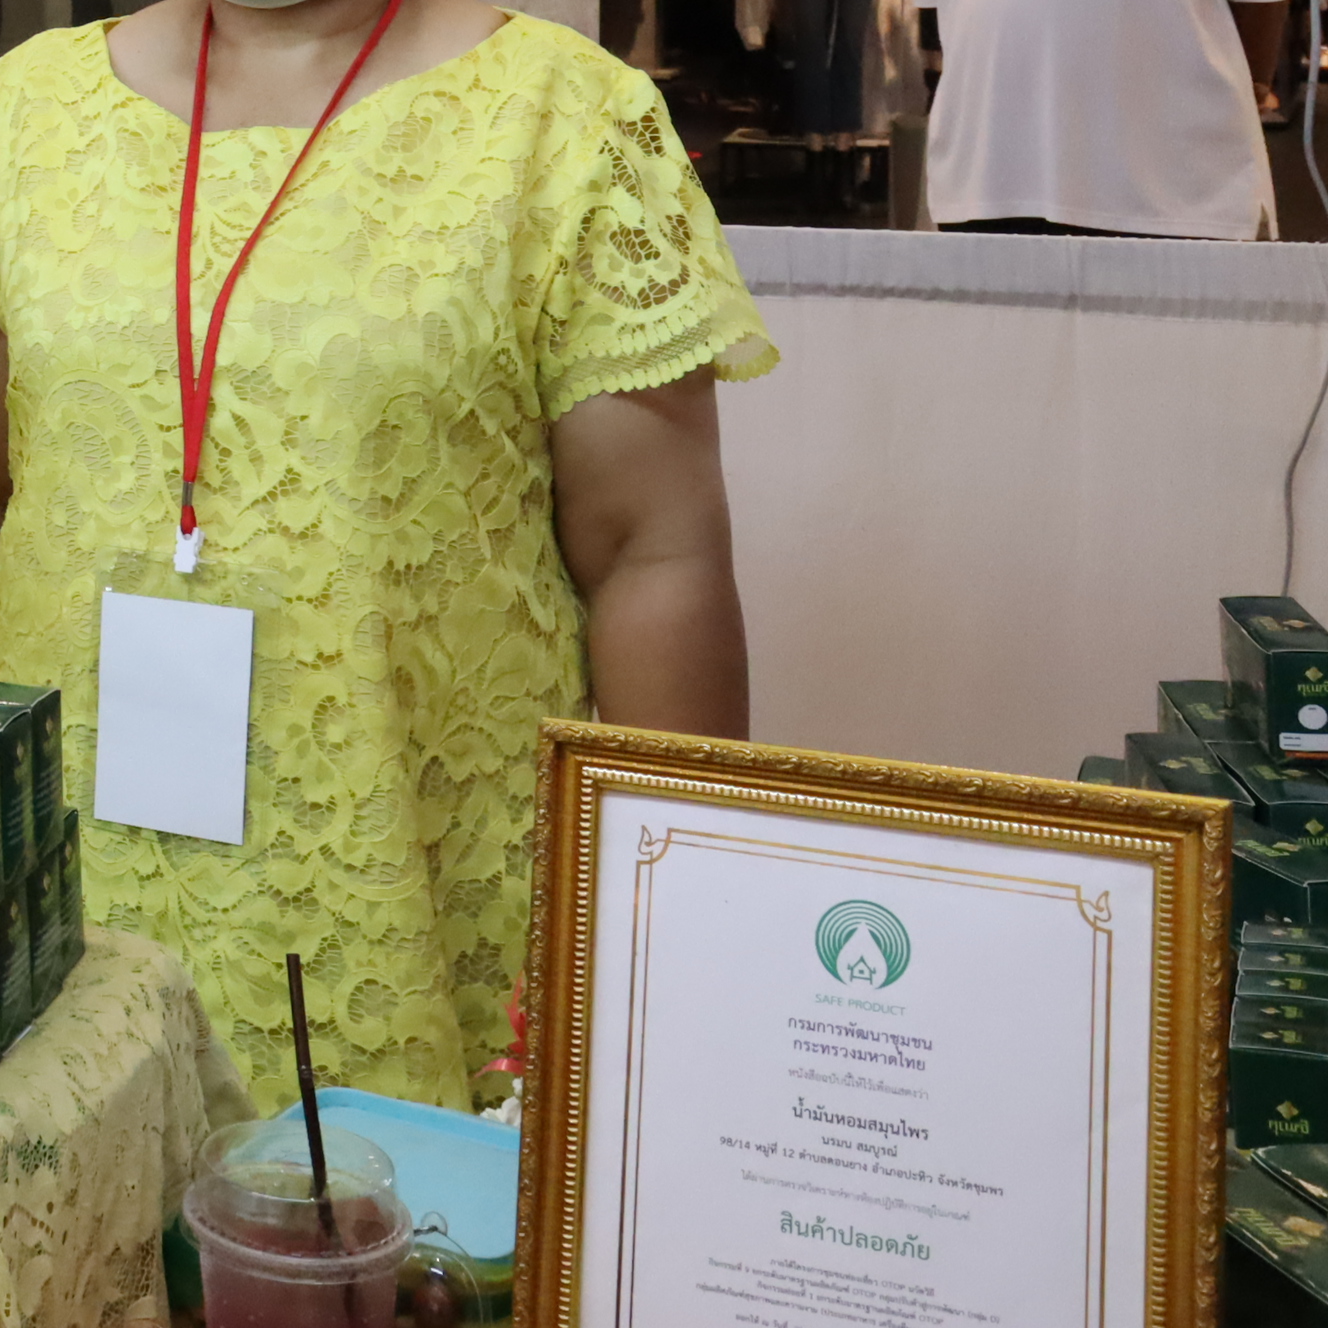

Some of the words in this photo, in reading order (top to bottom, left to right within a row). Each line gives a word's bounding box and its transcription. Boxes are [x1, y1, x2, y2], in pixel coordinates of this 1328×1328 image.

[815, 993, 843, 1007] SAFE
[848, 998, 906, 1017] PRODUCT
[787, 1015, 934, 1052] กรมการพัฒนาชุมชน
[793, 1037, 926, 1072] กระทรวงมหาดไทย
[792, 1096, 929, 1141] น้ำมันหอมสมุนไพร
[719, 1135, 751, 1151] 98/14
[782, 1147, 795, 1159] 12
[780, 1210, 931, 1262] สินค้าปลอดภัย
